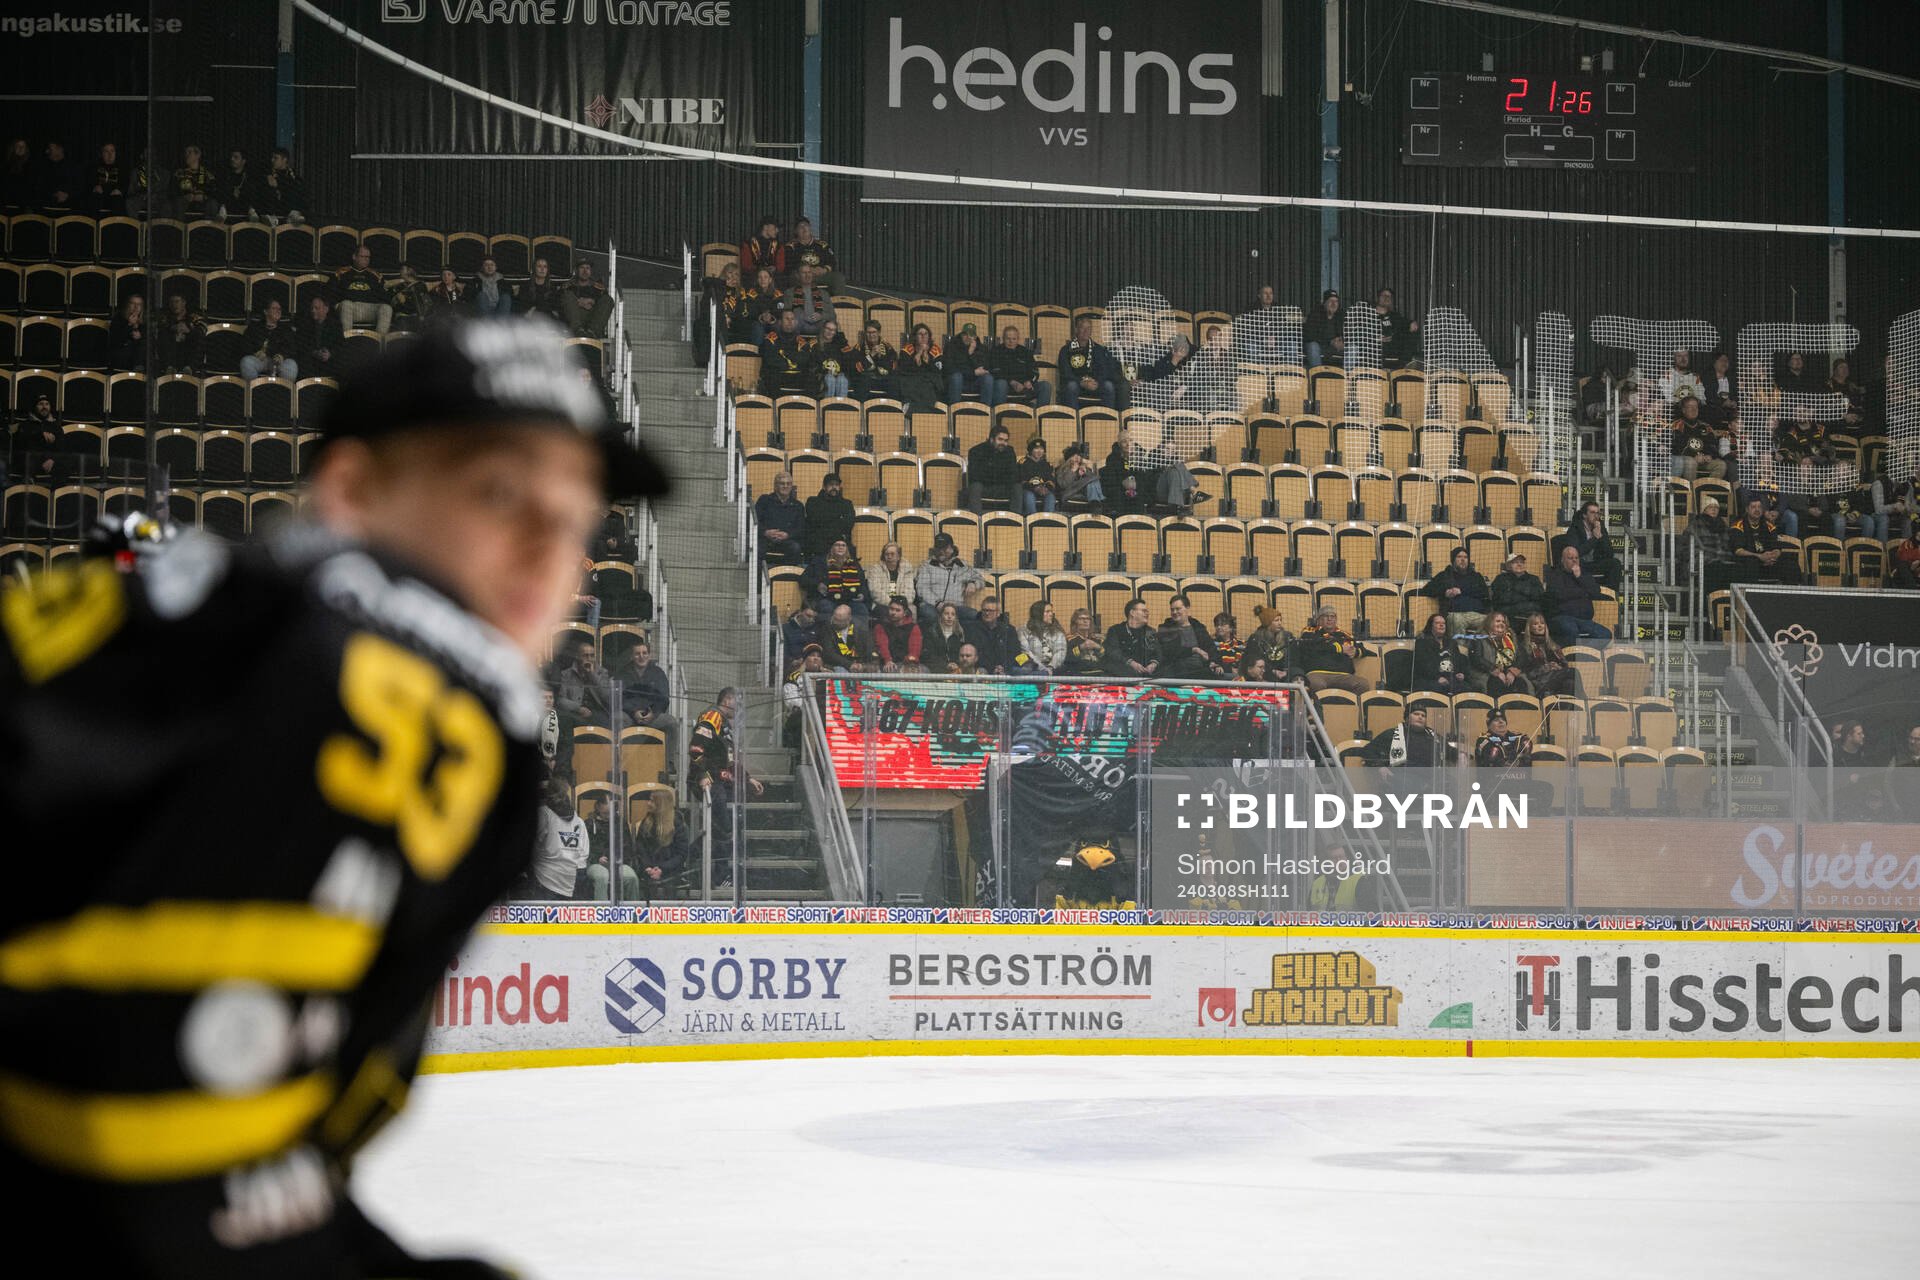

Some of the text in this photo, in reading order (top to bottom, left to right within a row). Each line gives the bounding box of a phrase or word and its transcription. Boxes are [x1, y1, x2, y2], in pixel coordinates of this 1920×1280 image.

[1419, 79, 1431, 88] Nr
[1466, 74, 1497, 83] Hemma
[1668, 80, 1692, 89] Gäster
[1615, 85, 1626, 93] Nr
[619, 98, 726, 125] NIBE
[1507, 116, 1532, 124] Period
[1419, 126, 1431, 135] Nr
[1530, 126, 1574, 138] H G
[1615, 131, 1626, 140] Nr
[558, 907, 634, 922] INTERSPORT
[649, 907, 730, 922] INTERSPORT
[745, 908, 829, 922] INTERSPORT
[845, 908, 932, 922] INTERSPORT
[948, 908, 1038, 924] INTERSPORT
[1054, 910, 1144, 924] INTERSPORT
[1162, 910, 1255, 925] INTERSPORT
[1273, 912, 1366, 926] INTERSPORT
[1382, 913, 1474, 927] INTERSPORT
[1706, 918, 1794, 930] INTERSPORT
[1812, 919, 1900, 931] INTERSPORT
[682, 946, 847, 1000] SÖRBY
[889, 946, 1153, 987] BERGSTRÖM
[1271, 951, 1362, 988] EURO
[1243, 985, 1396, 1027] JACKPOT
[682, 1009, 846, 1033] JÄRN & METALL
[915, 1006, 1124, 1032] PLATTSÄTTNING
